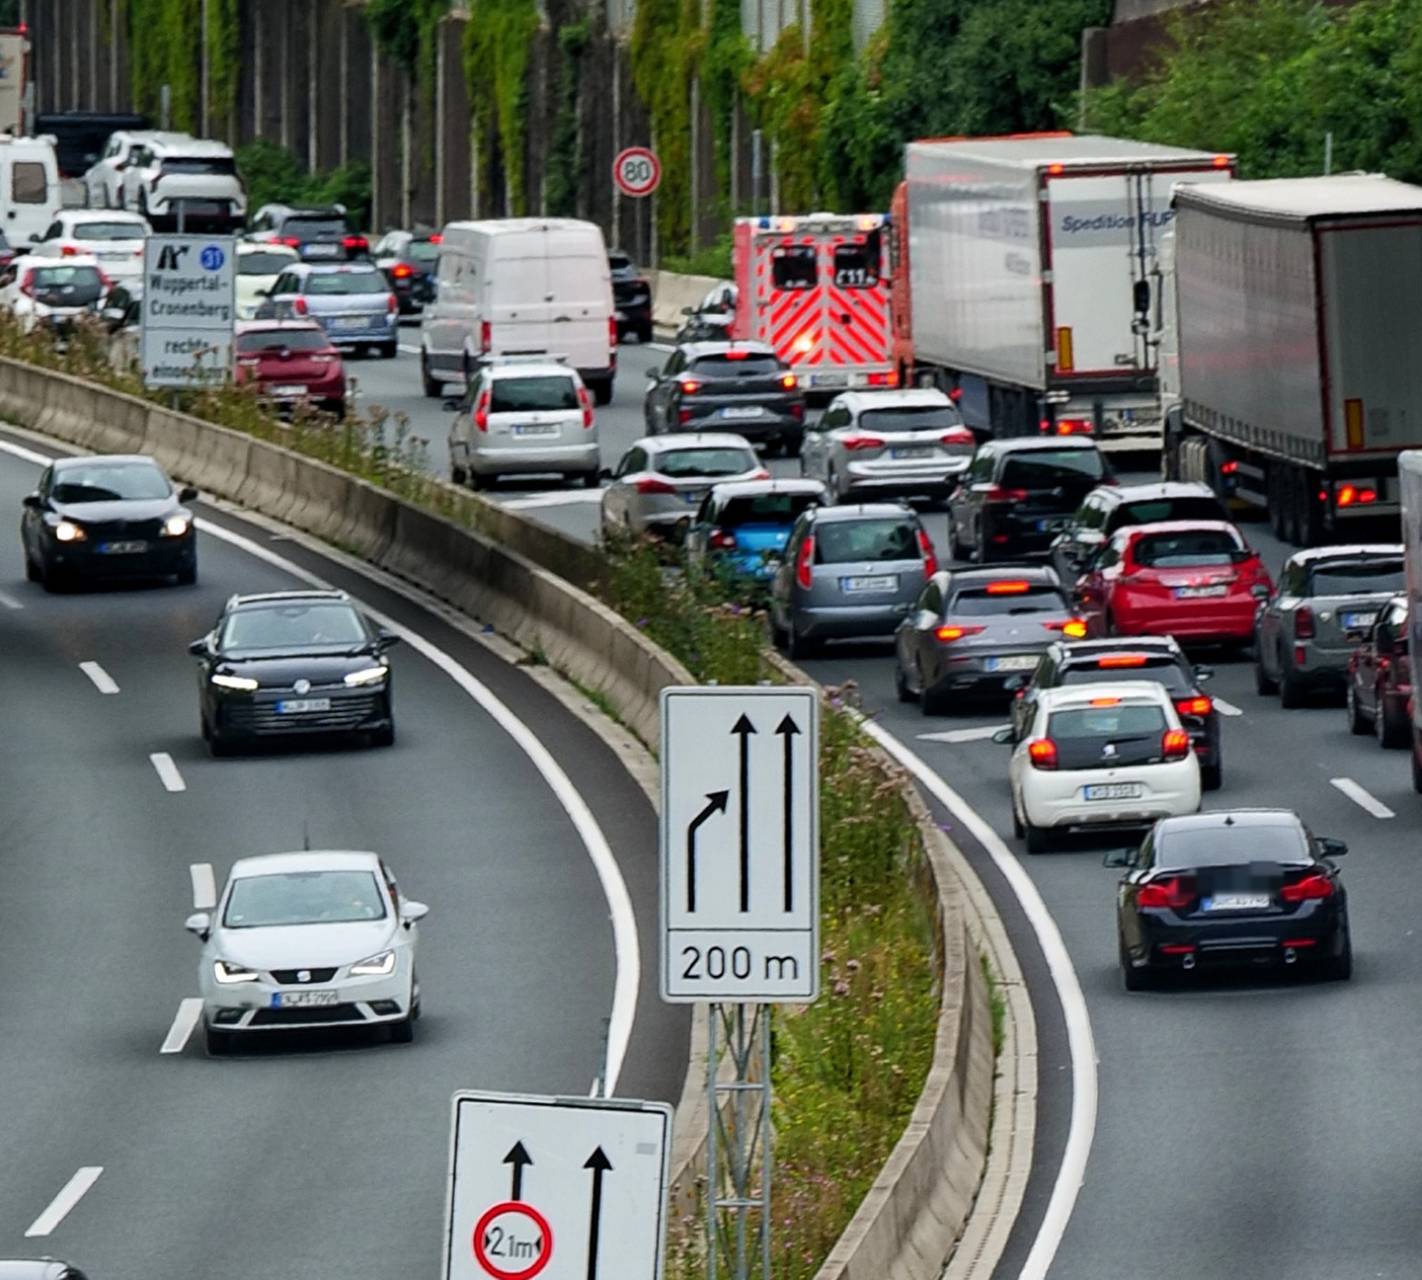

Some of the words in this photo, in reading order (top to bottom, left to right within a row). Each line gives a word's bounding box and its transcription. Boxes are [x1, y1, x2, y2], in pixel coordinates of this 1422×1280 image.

[624, 161, 650, 182] 80
[1061, 212, 1135, 234] Spedition
[151, 275, 228, 295] Wuppertal-
[151, 301, 229, 321] Cronenberg
[682, 945, 751, 980] 200
[764, 955, 798, 980] m
